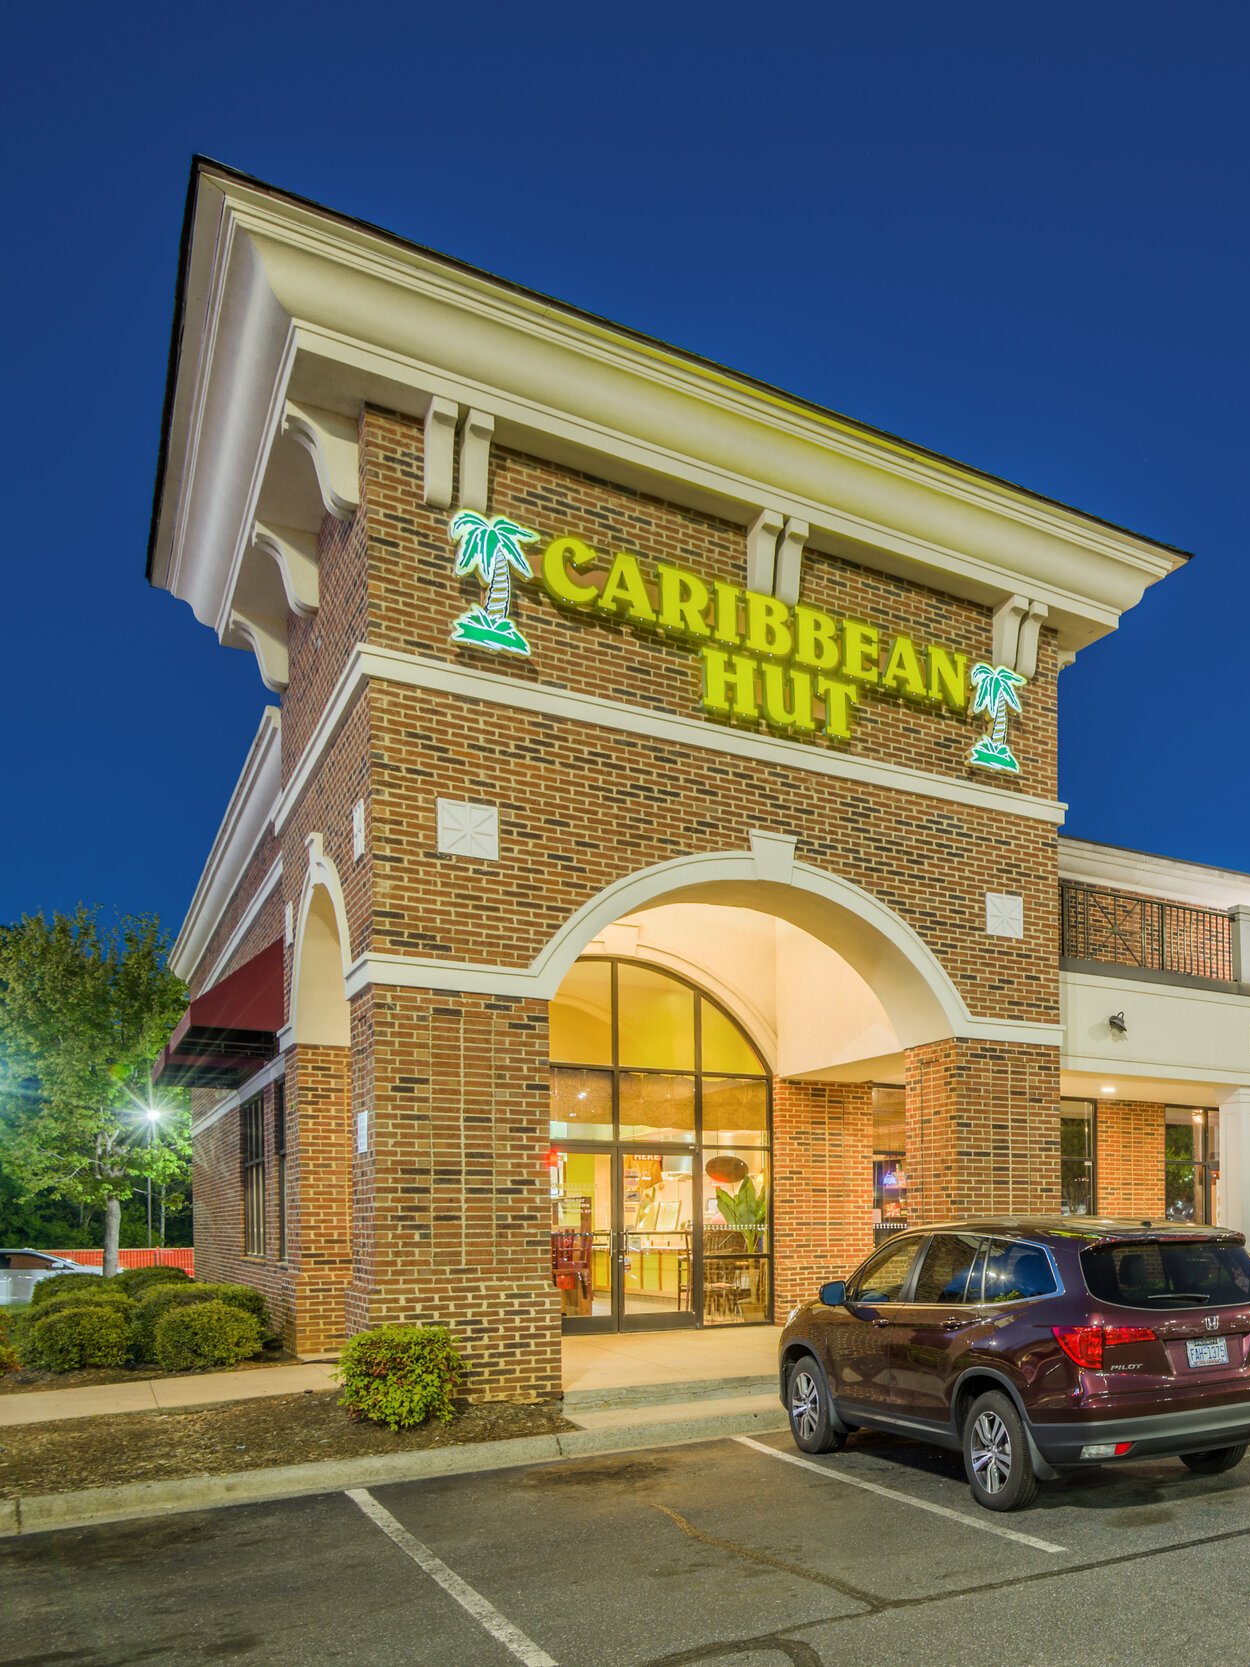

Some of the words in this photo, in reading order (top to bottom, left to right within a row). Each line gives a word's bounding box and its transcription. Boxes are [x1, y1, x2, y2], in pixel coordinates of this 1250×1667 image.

[542, 537, 967, 707] CARIBBEAN
[700, 647, 858, 741] HUT
[1110, 1363, 1144, 1371] PILOT
[1190, 1345, 1225, 1361] FAH-1375
